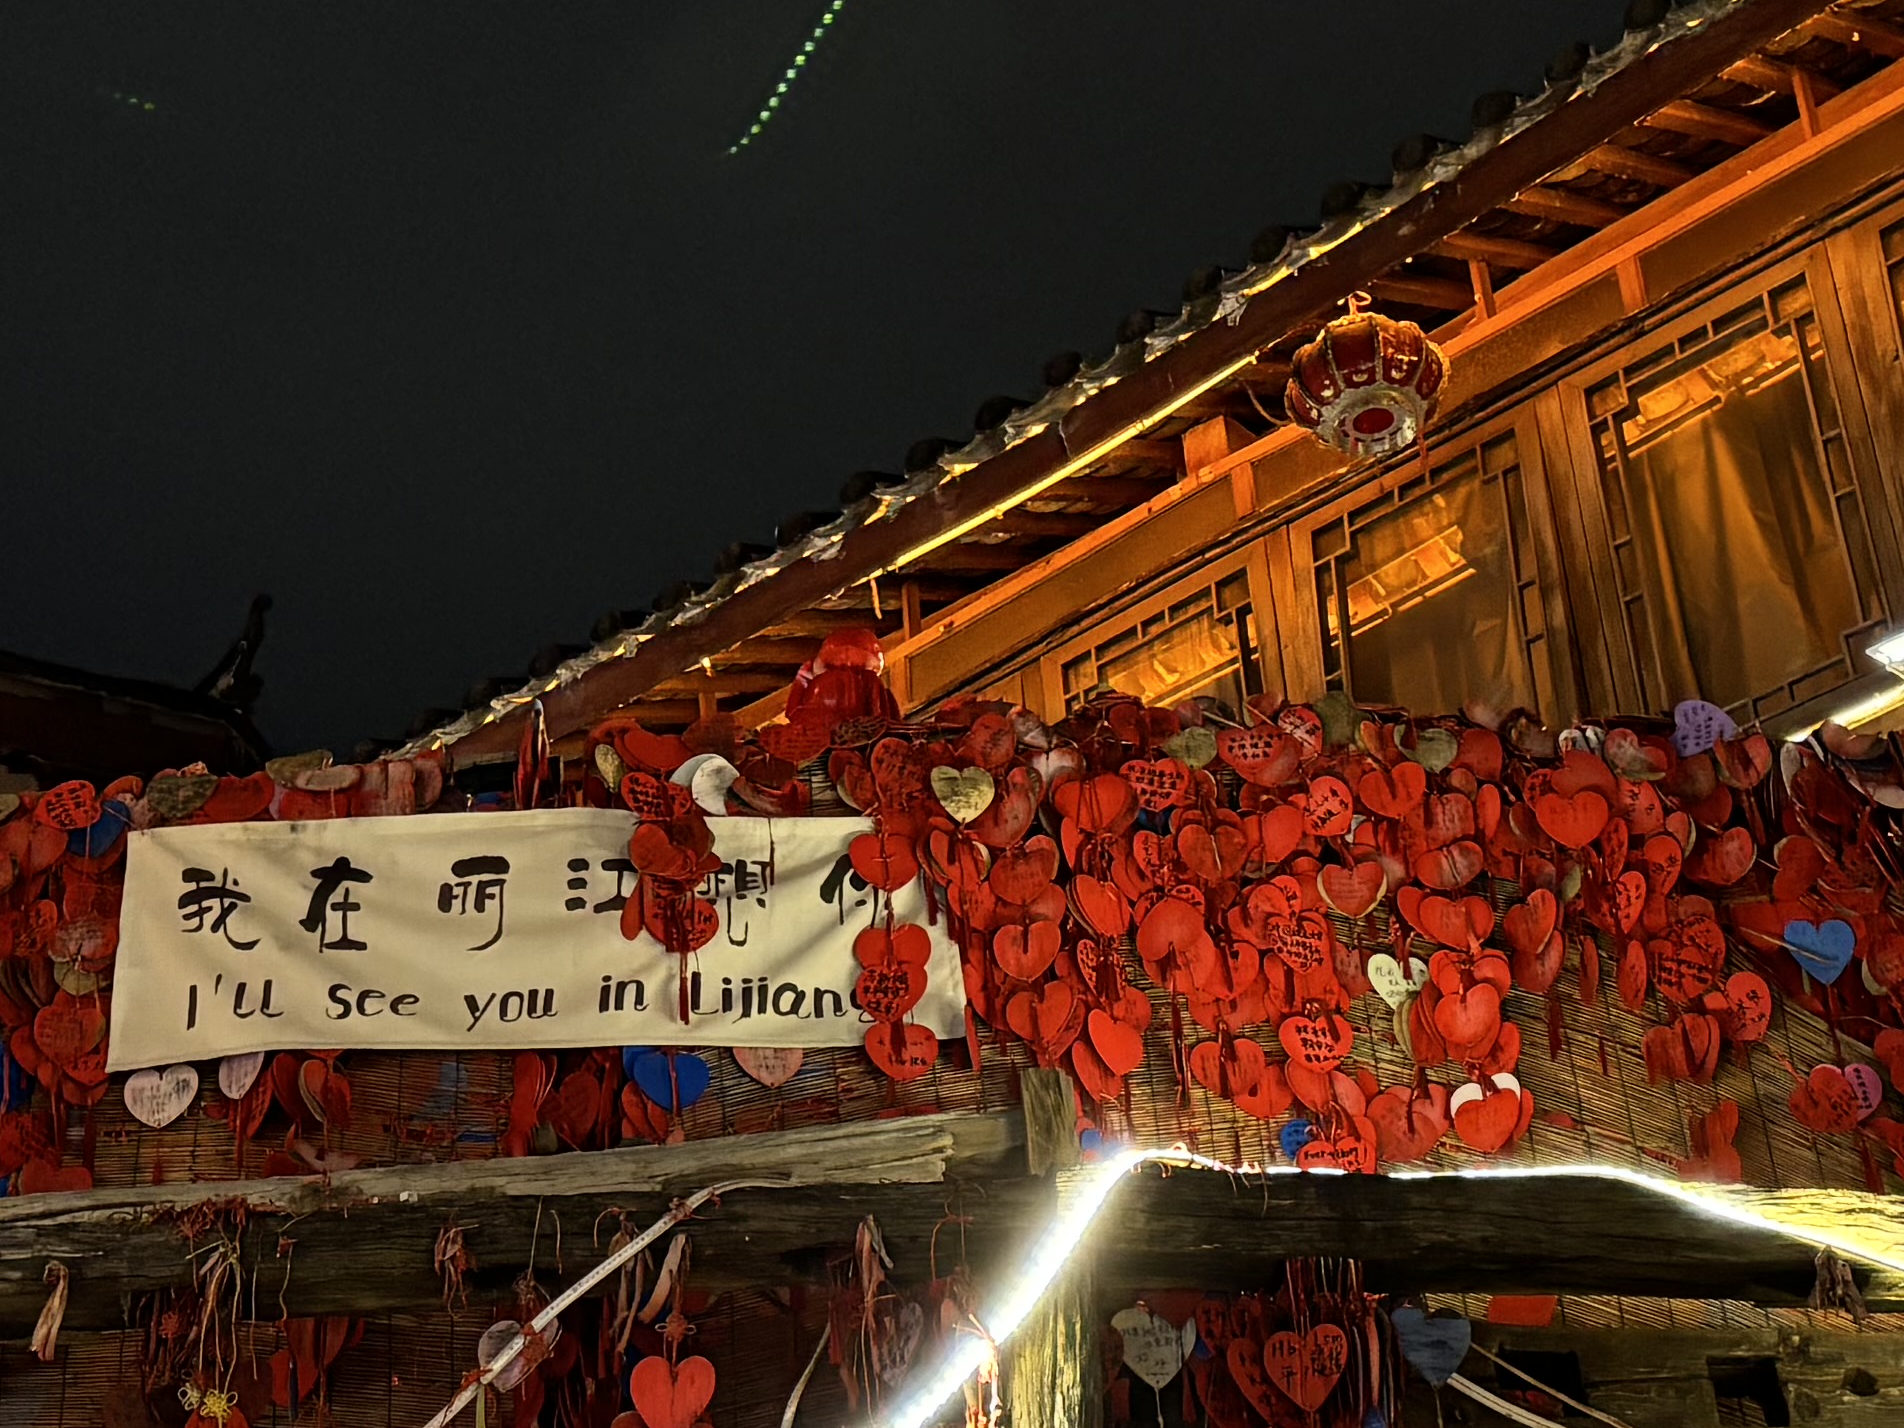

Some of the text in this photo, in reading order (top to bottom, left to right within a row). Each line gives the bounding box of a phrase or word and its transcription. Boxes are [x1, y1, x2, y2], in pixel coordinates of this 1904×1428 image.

[186, 974, 284, 1031] I'll
[463, 987, 558, 1032] you
[598, 974, 649, 1014] in
